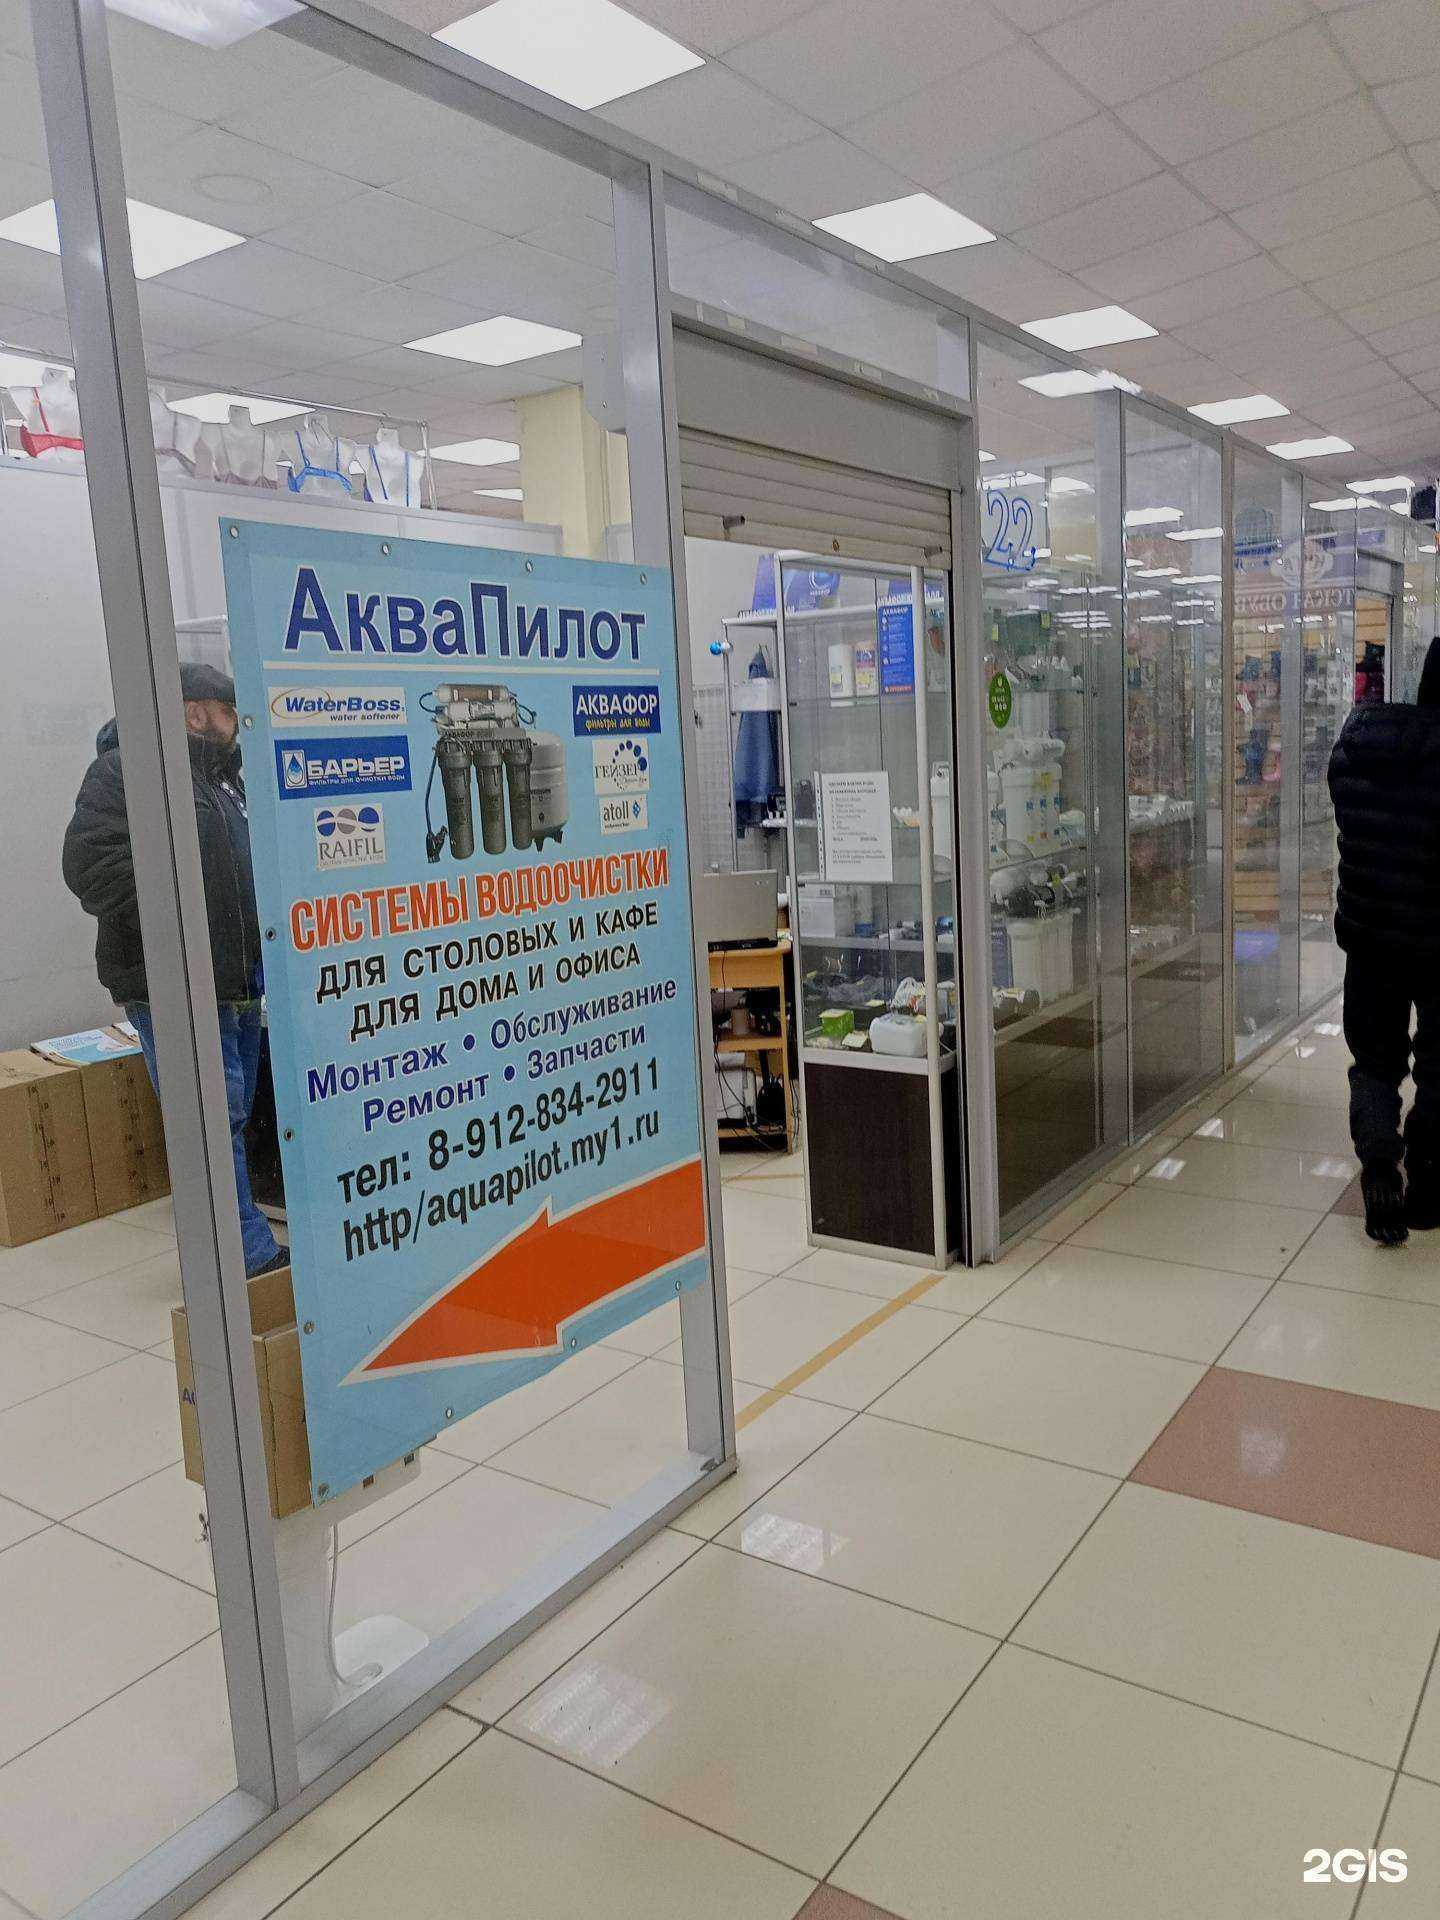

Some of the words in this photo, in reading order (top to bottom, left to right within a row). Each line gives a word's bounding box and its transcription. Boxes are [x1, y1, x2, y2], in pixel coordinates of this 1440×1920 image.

[284, 567, 646, 660] АкваПилот
[285, 696, 401, 712] WaterBoss
[361, 713, 400, 721] softener
[576, 694, 657, 716] АКВАФОР
[307, 756, 405, 780] БАРЬЕР
[319, 837, 383, 860] RAIFIL
[603, 800, 629, 822] atoll
[291, 877, 469, 951] СИСТЕМЫ
[475, 849, 668, 918] ВОДООЧИСТКИ
[403, 921, 559, 978] СТОЛОВЫХ
[569, 916, 585, 942] И
[596, 901, 658, 936] КАФЕ
[436, 971, 519, 1022] ДОМА
[529, 963, 544, 991] И
[556, 943, 641, 983] ОФИСА
[307, 1042, 448, 1103] Монтаж
[491, 979, 677, 1049] Обслуживание
[363, 1074, 489, 1132] Ремонт
[527, 1025, 646, 1079] Запчасти
[337, 1151, 411, 1204] тел:
[428, 1057, 658, 1171] 8-912-834-2911
[343, 1110, 660, 1262] http/aquapilot.my1.ru
